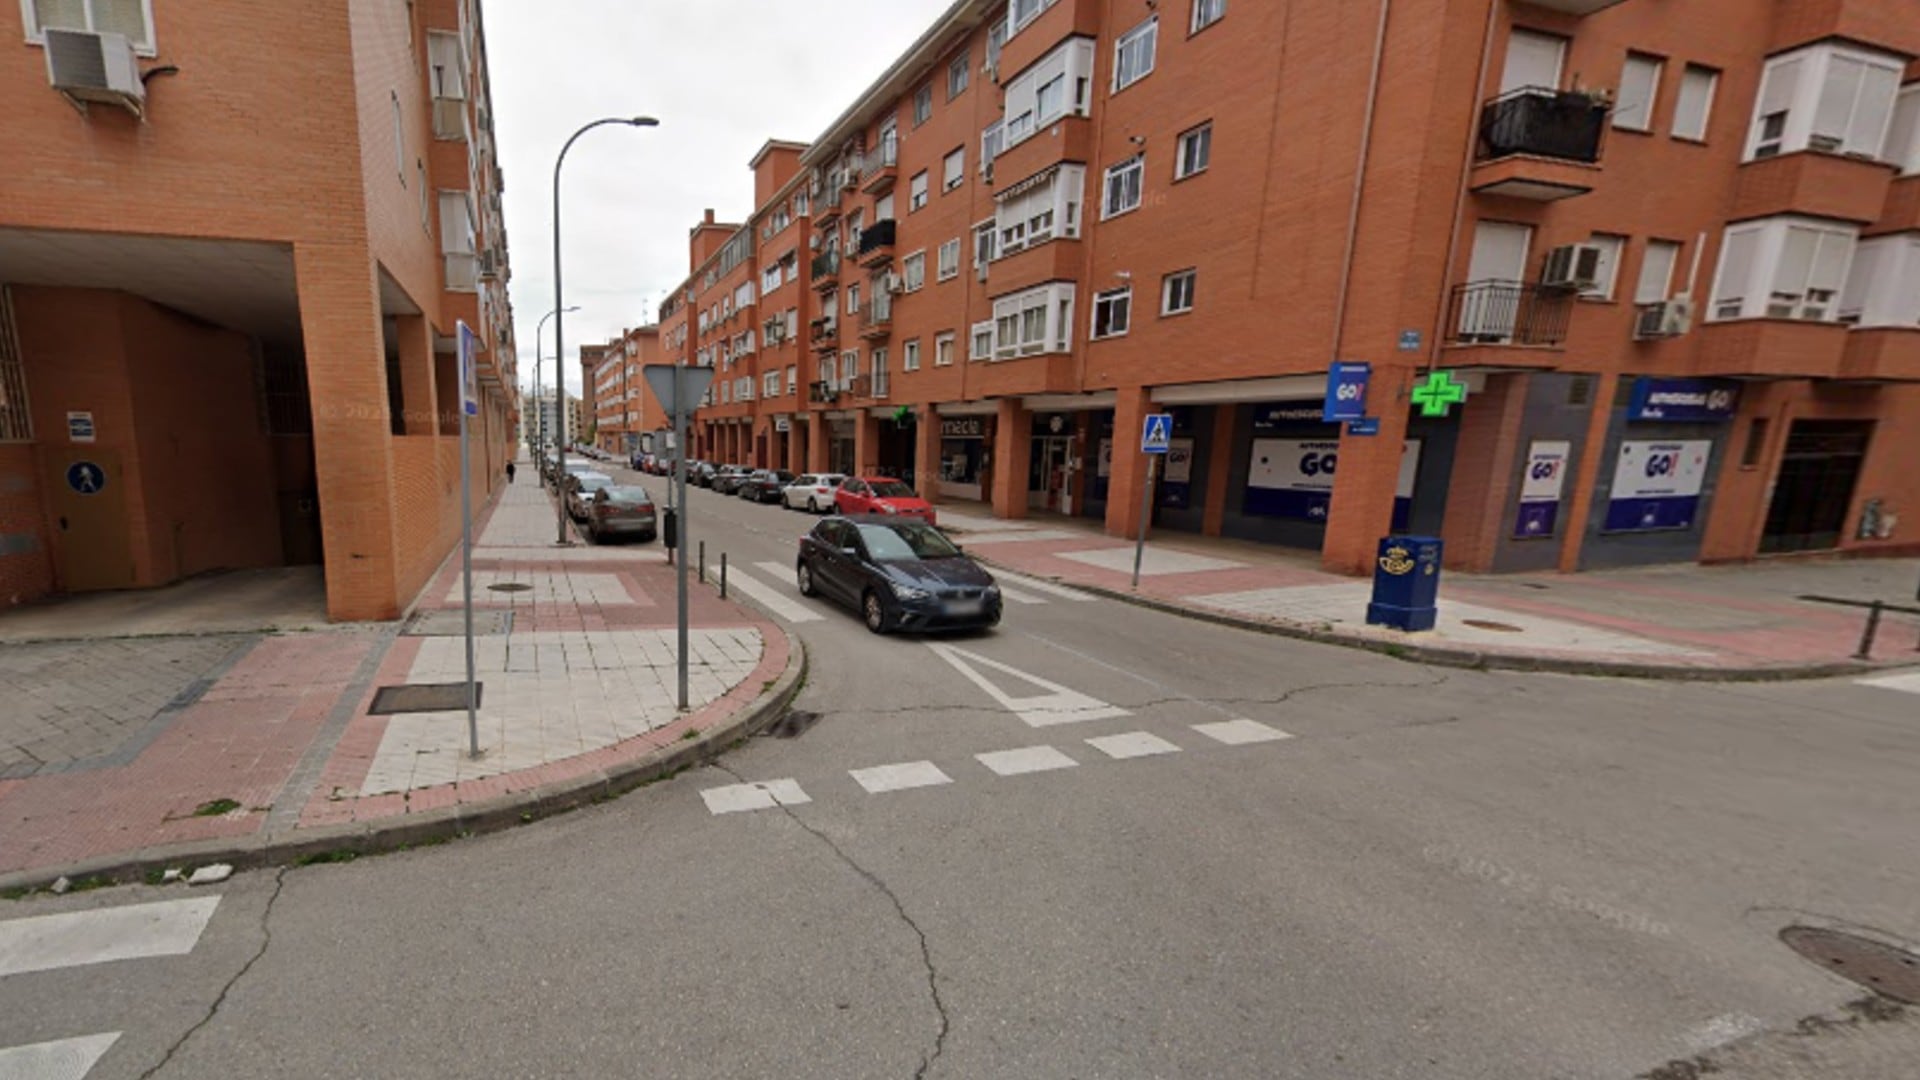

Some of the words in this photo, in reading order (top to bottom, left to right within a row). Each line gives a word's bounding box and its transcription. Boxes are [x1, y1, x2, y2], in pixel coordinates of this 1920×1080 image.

[1336, 383, 1364, 400] GO!
[1532, 462, 1560, 480] GO!
[1646, 453, 1679, 477] GO!
